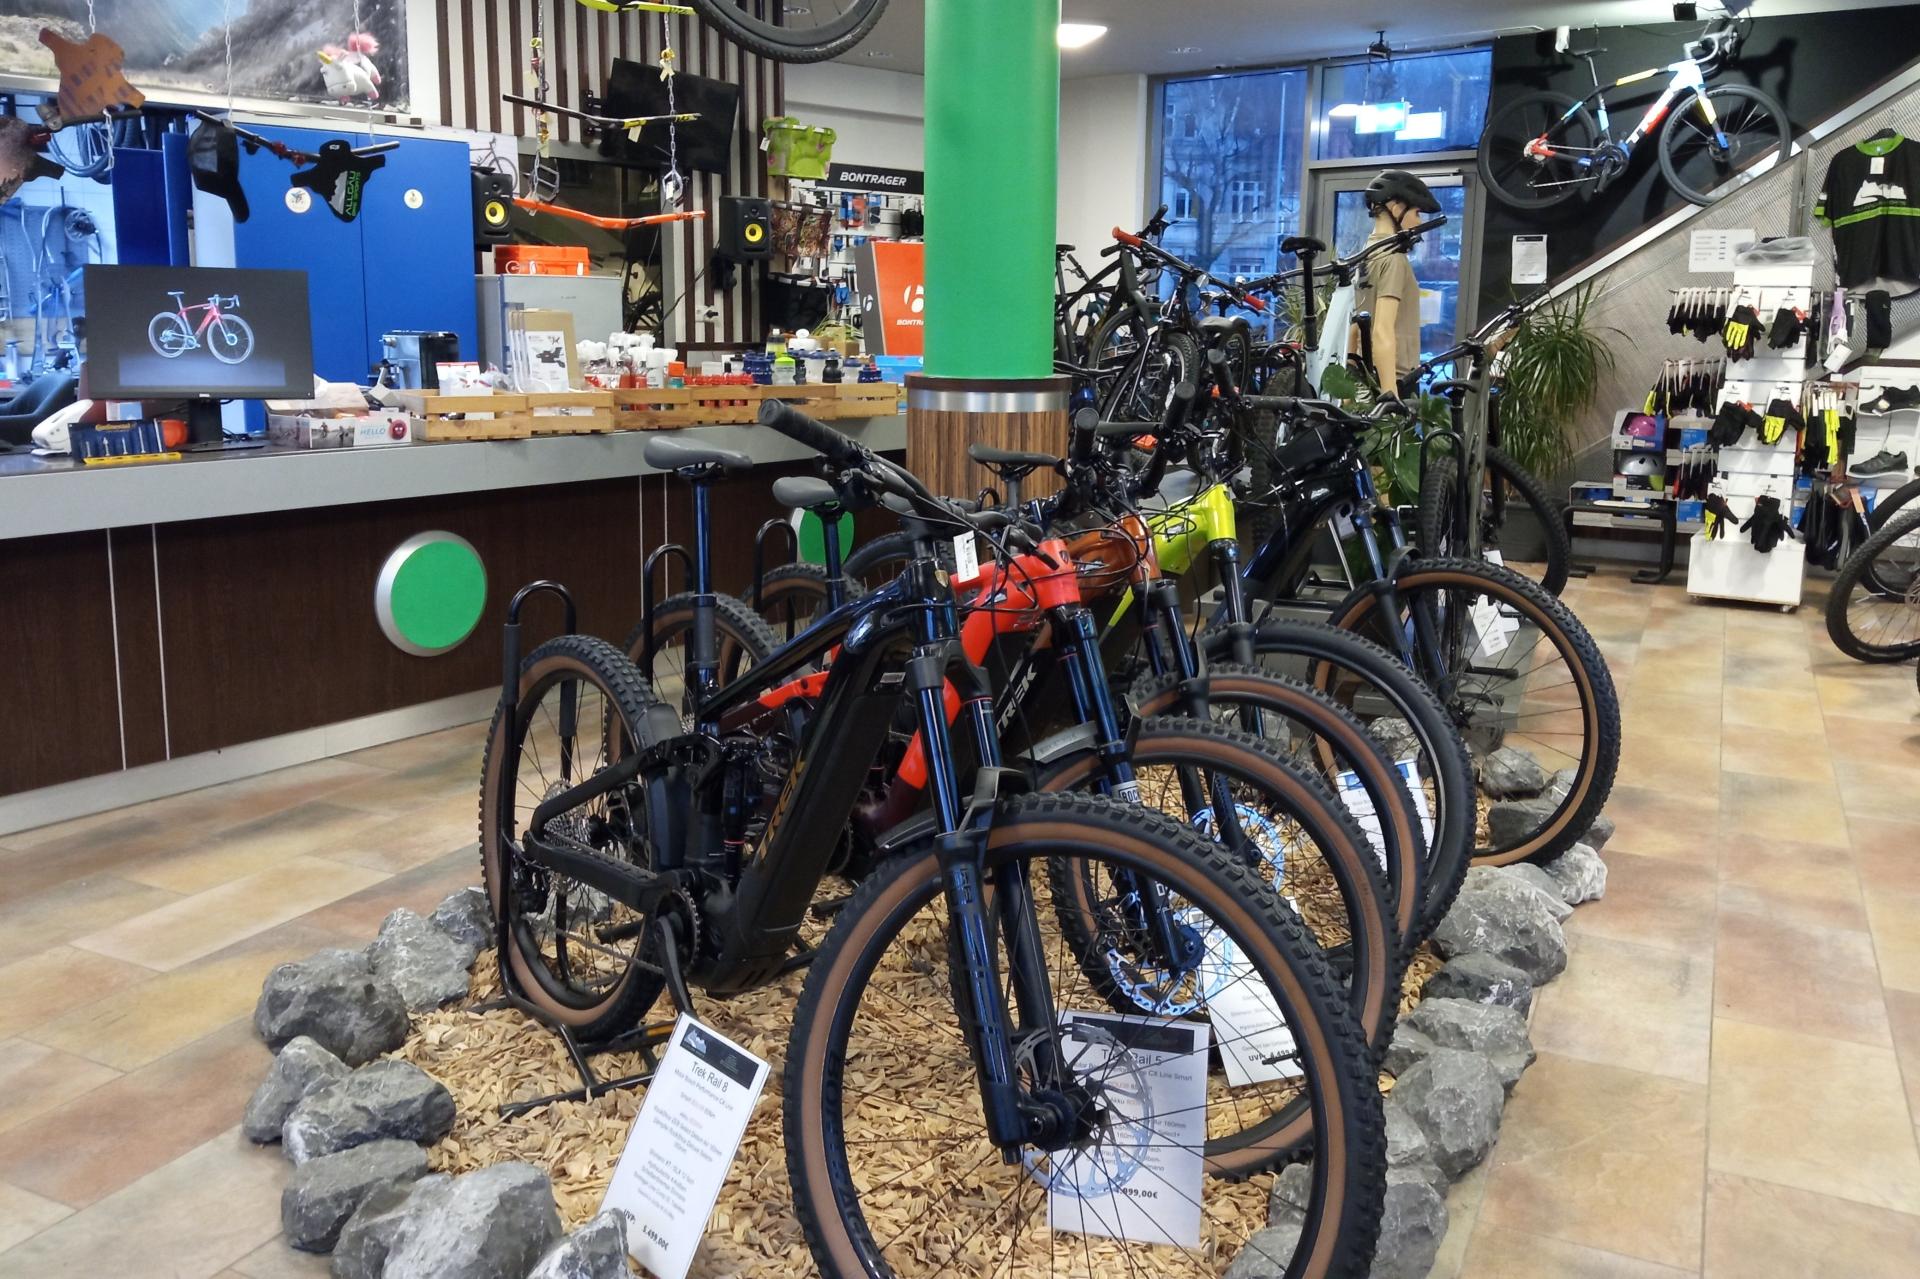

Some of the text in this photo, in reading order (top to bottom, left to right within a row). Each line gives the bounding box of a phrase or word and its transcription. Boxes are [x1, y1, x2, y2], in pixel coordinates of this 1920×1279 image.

[840, 171, 907, 187] BONTRAGER
[997, 662, 1038, 738] TREK
[1121, 788, 1139, 802] ROC
[691, 1061, 706, 1079] Trek
[707, 1072, 723, 1088] Rail
[722, 1081, 729, 1093] 8
